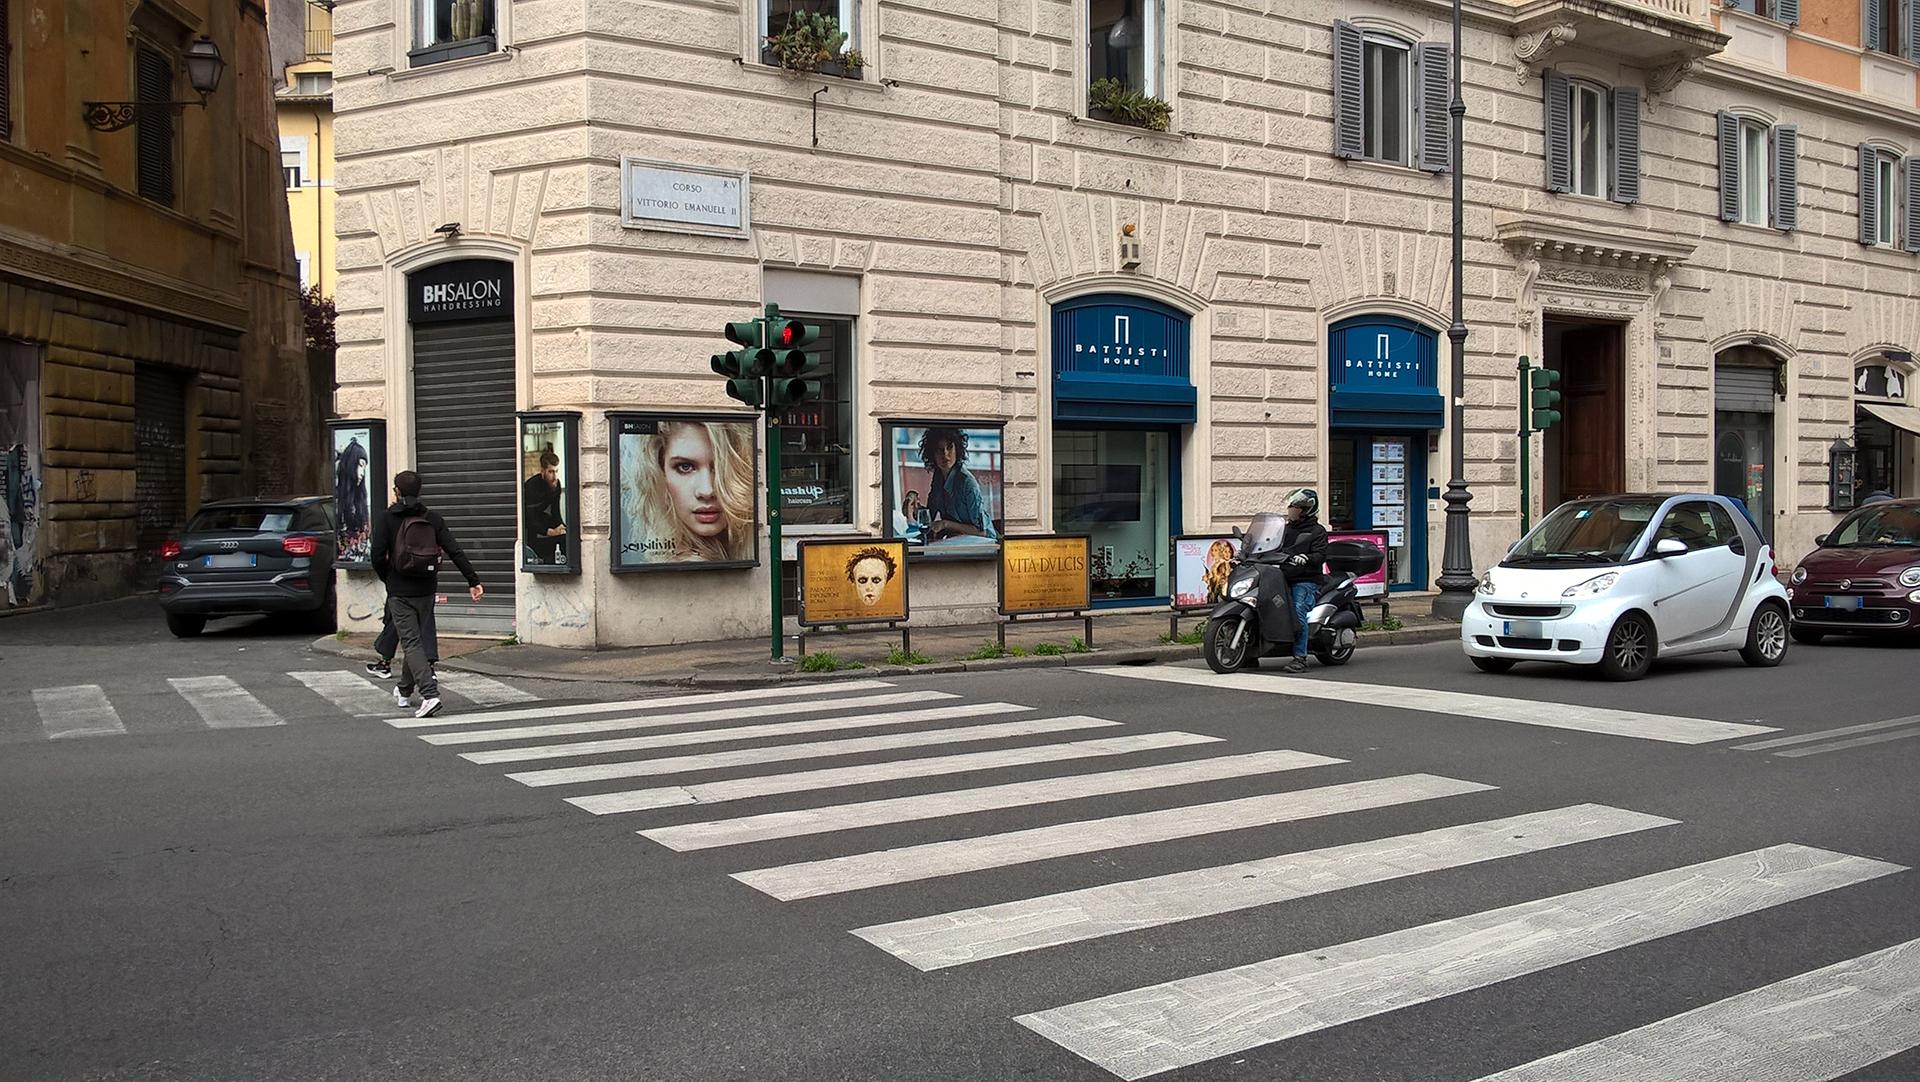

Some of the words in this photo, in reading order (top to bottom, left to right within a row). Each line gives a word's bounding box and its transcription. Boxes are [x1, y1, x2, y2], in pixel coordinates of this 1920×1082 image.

[672, 182, 702, 193] CORSO
[637, 198, 679, 210] VITTORIO
[684, 202, 726, 215] EMANUELE
[423, 279, 501, 304] BHSALON
[423, 299, 501, 313] HAIRDRESSING
[1075, 344, 1167, 357] BATTISTI
[1103, 357, 1140, 366] HOME
[1345, 360, 1420, 370] BATTISTI
[1368, 370, 1398, 378] HOME
